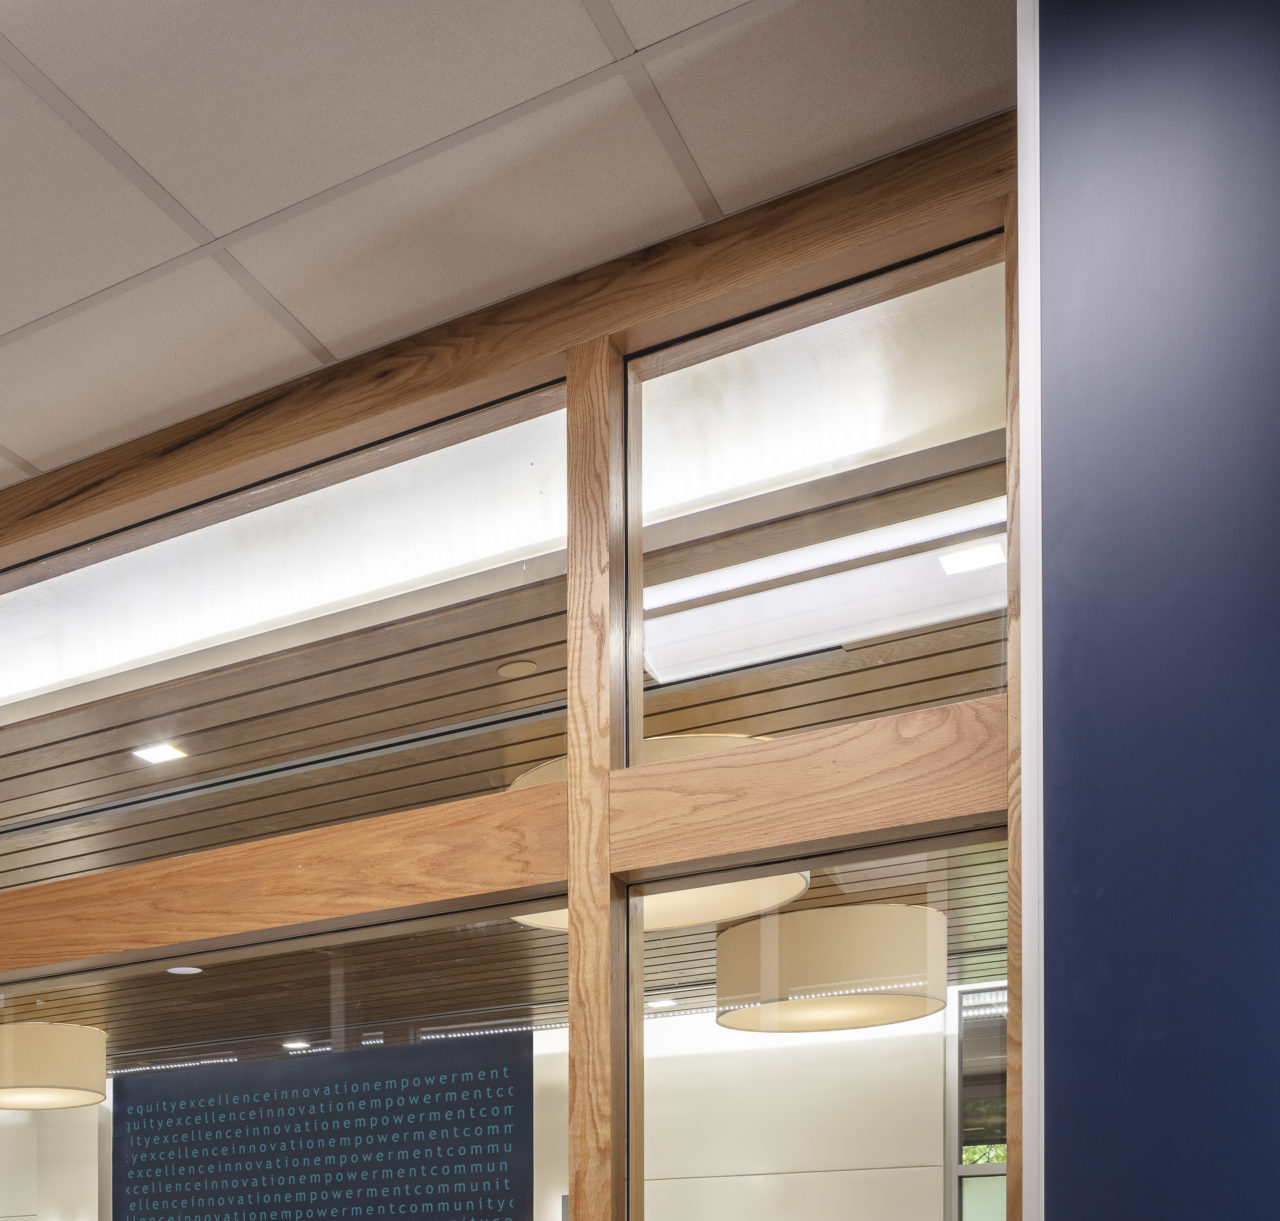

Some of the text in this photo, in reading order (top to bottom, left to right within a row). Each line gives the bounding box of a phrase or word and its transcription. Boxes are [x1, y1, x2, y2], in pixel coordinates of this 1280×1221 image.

[127, 1066, 509, 1116] equityexcellenceinnovationempowerment
[127, 1142, 512, 1179] excellenceinnovationempowermentcommu
[129, 1177, 510, 1212] ellenceinnovationempowermentcommunit
